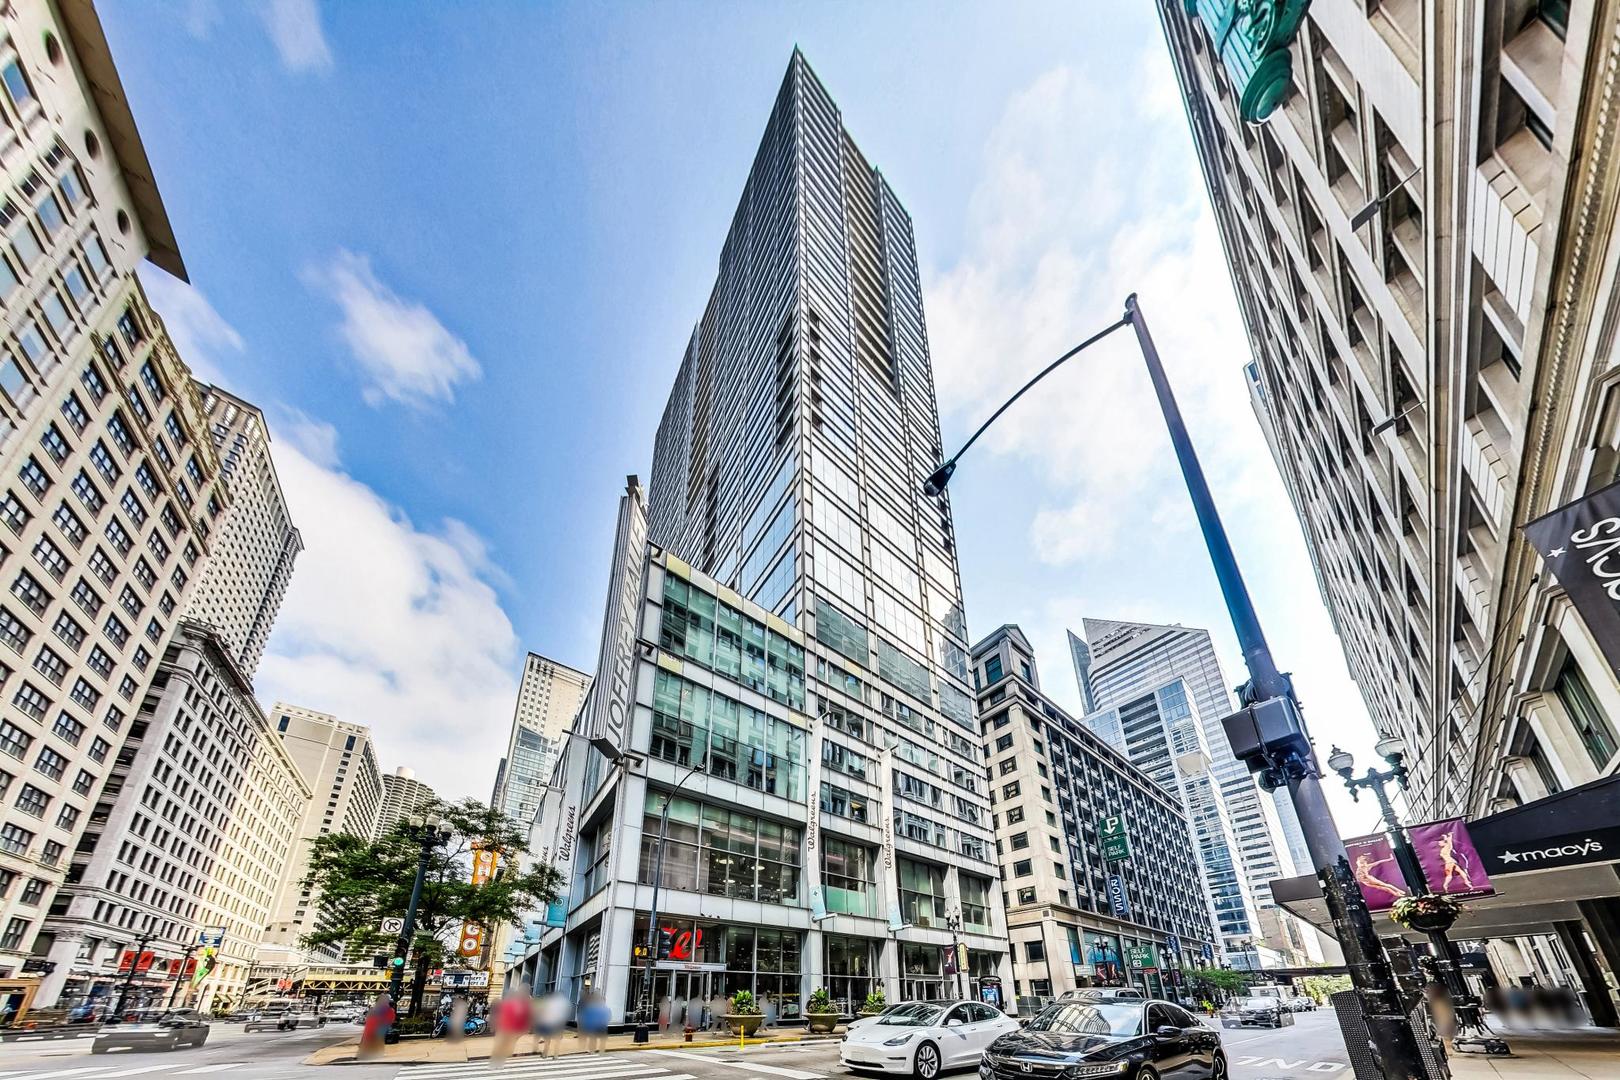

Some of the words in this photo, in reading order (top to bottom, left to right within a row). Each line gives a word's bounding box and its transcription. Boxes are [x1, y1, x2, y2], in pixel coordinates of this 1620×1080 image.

[607, 611, 635, 748] JOFFREY
[558, 805, 576, 862] Walgreens
[807, 791, 818, 852] Walgreens
[884, 816, 893, 870] Walgreens
[1521, 838, 1603, 862] macy's
[1111, 879, 1124, 911] ROSS
